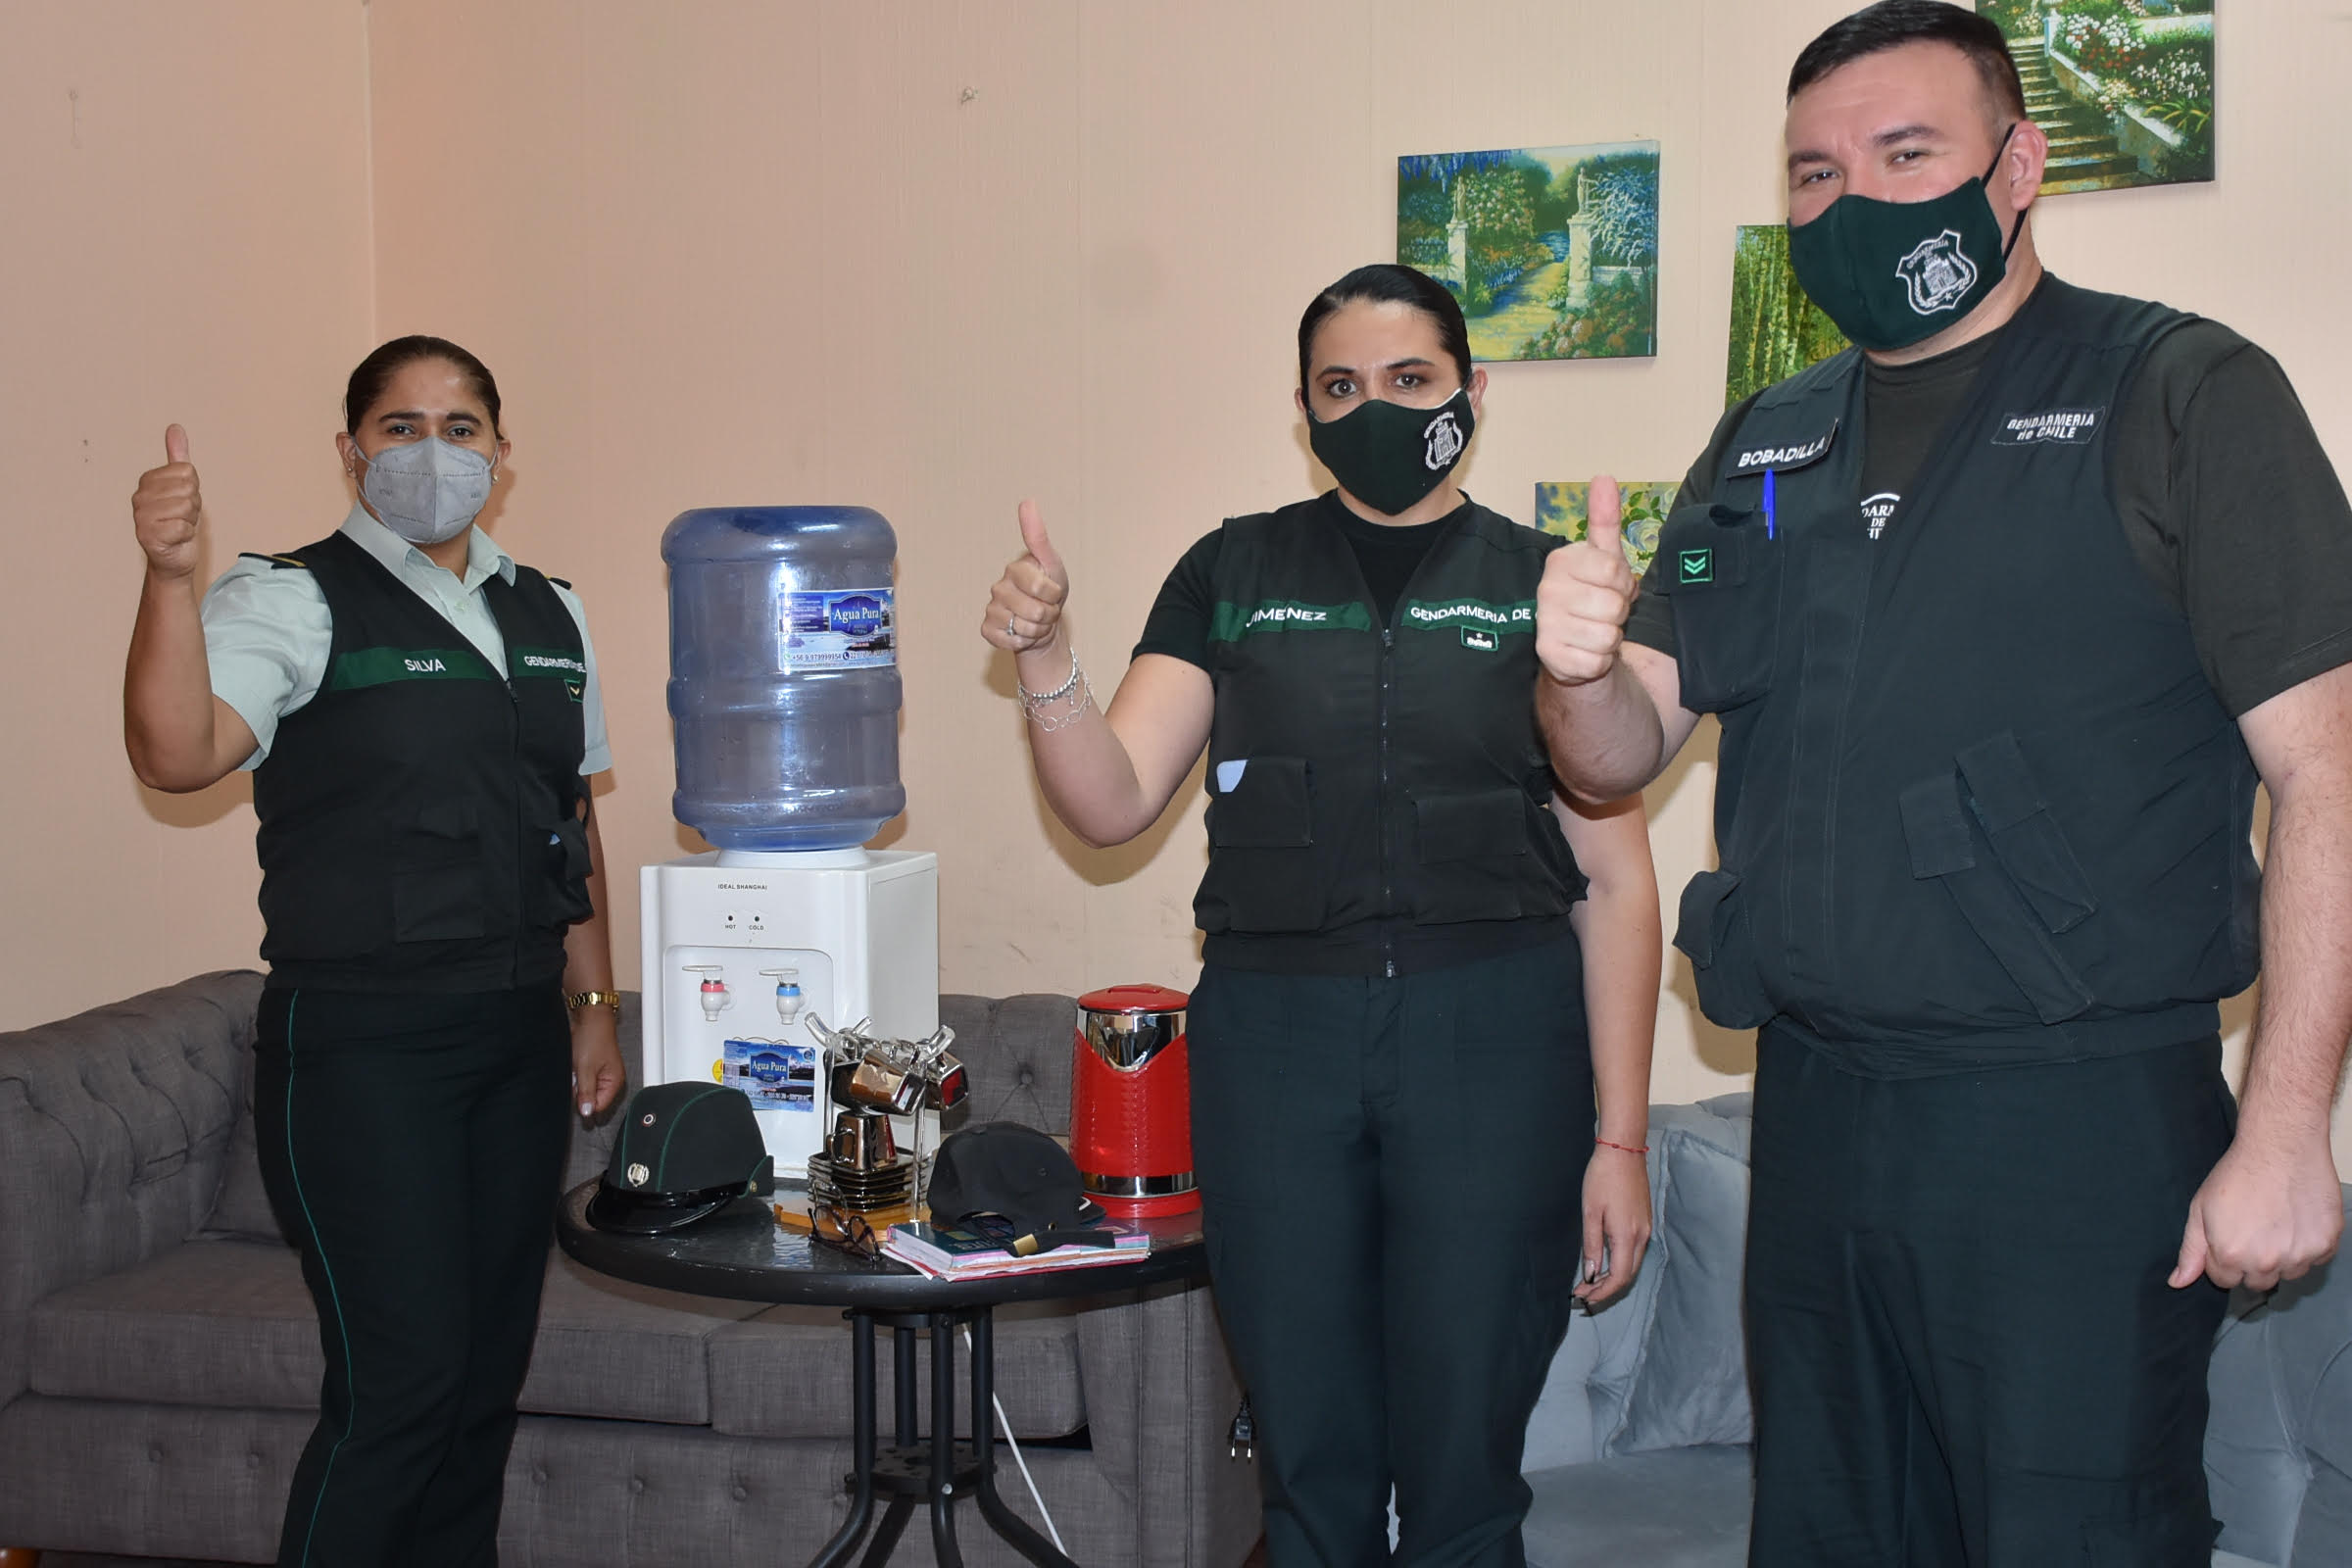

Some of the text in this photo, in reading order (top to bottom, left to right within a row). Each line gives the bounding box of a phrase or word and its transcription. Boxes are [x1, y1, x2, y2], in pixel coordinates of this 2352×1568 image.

[2006, 413, 2095, 430] GENDARMERIA
[2036, 425, 2078, 439] CHILE
[1738, 436, 1826, 467] BOBADILLA
[1870, 517, 1886, 527] DE
[833, 607, 879, 623] Agua Pura
[1246, 607, 1328, 628] JIMENEZ
[1410, 605, 1507, 624] GENDARMERIA
[1511, 609, 1532, 620] DE
[404, 658, 447, 673] SILVA
[752, 1059, 787, 1073] Agua Pura
